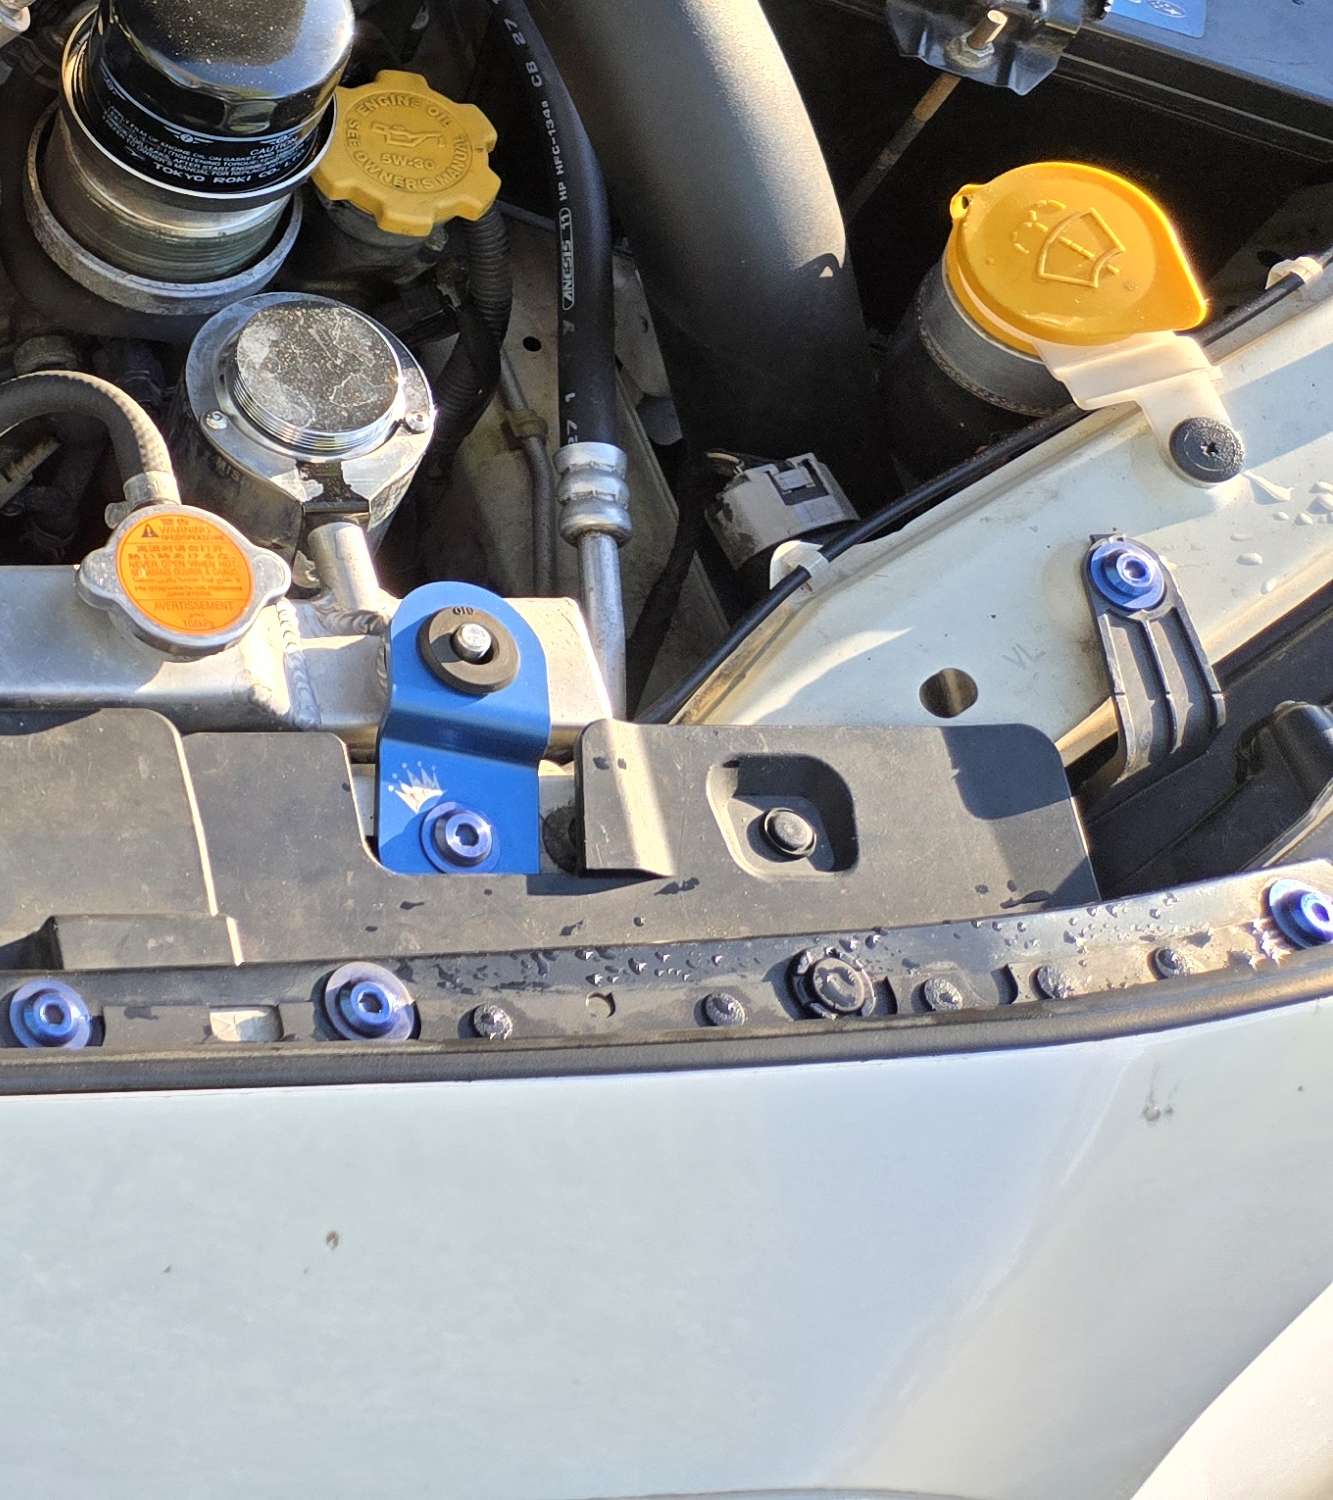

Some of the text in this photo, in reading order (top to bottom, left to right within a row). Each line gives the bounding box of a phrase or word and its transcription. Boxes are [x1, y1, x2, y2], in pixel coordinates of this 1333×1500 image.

[502, 13, 527, 48] 27
[523, 59, 544, 89] CB
[356, 94, 453, 129] ENGINE OIL
[249, 136, 298, 156] CAUTION
[541, 100, 565, 176] HFC-134a
[345, 118, 470, 190] SEE OWNER'S MANUAL
[380, 152, 436, 171] 5W-30
[153, 161, 206, 182] TOKYO
[213, 175, 252, 184] ROKI
[557, 181, 567, 201] HP
[159, 525, 211, 534] WARNING
[153, 601, 234, 611] AVERTISSEMENT
